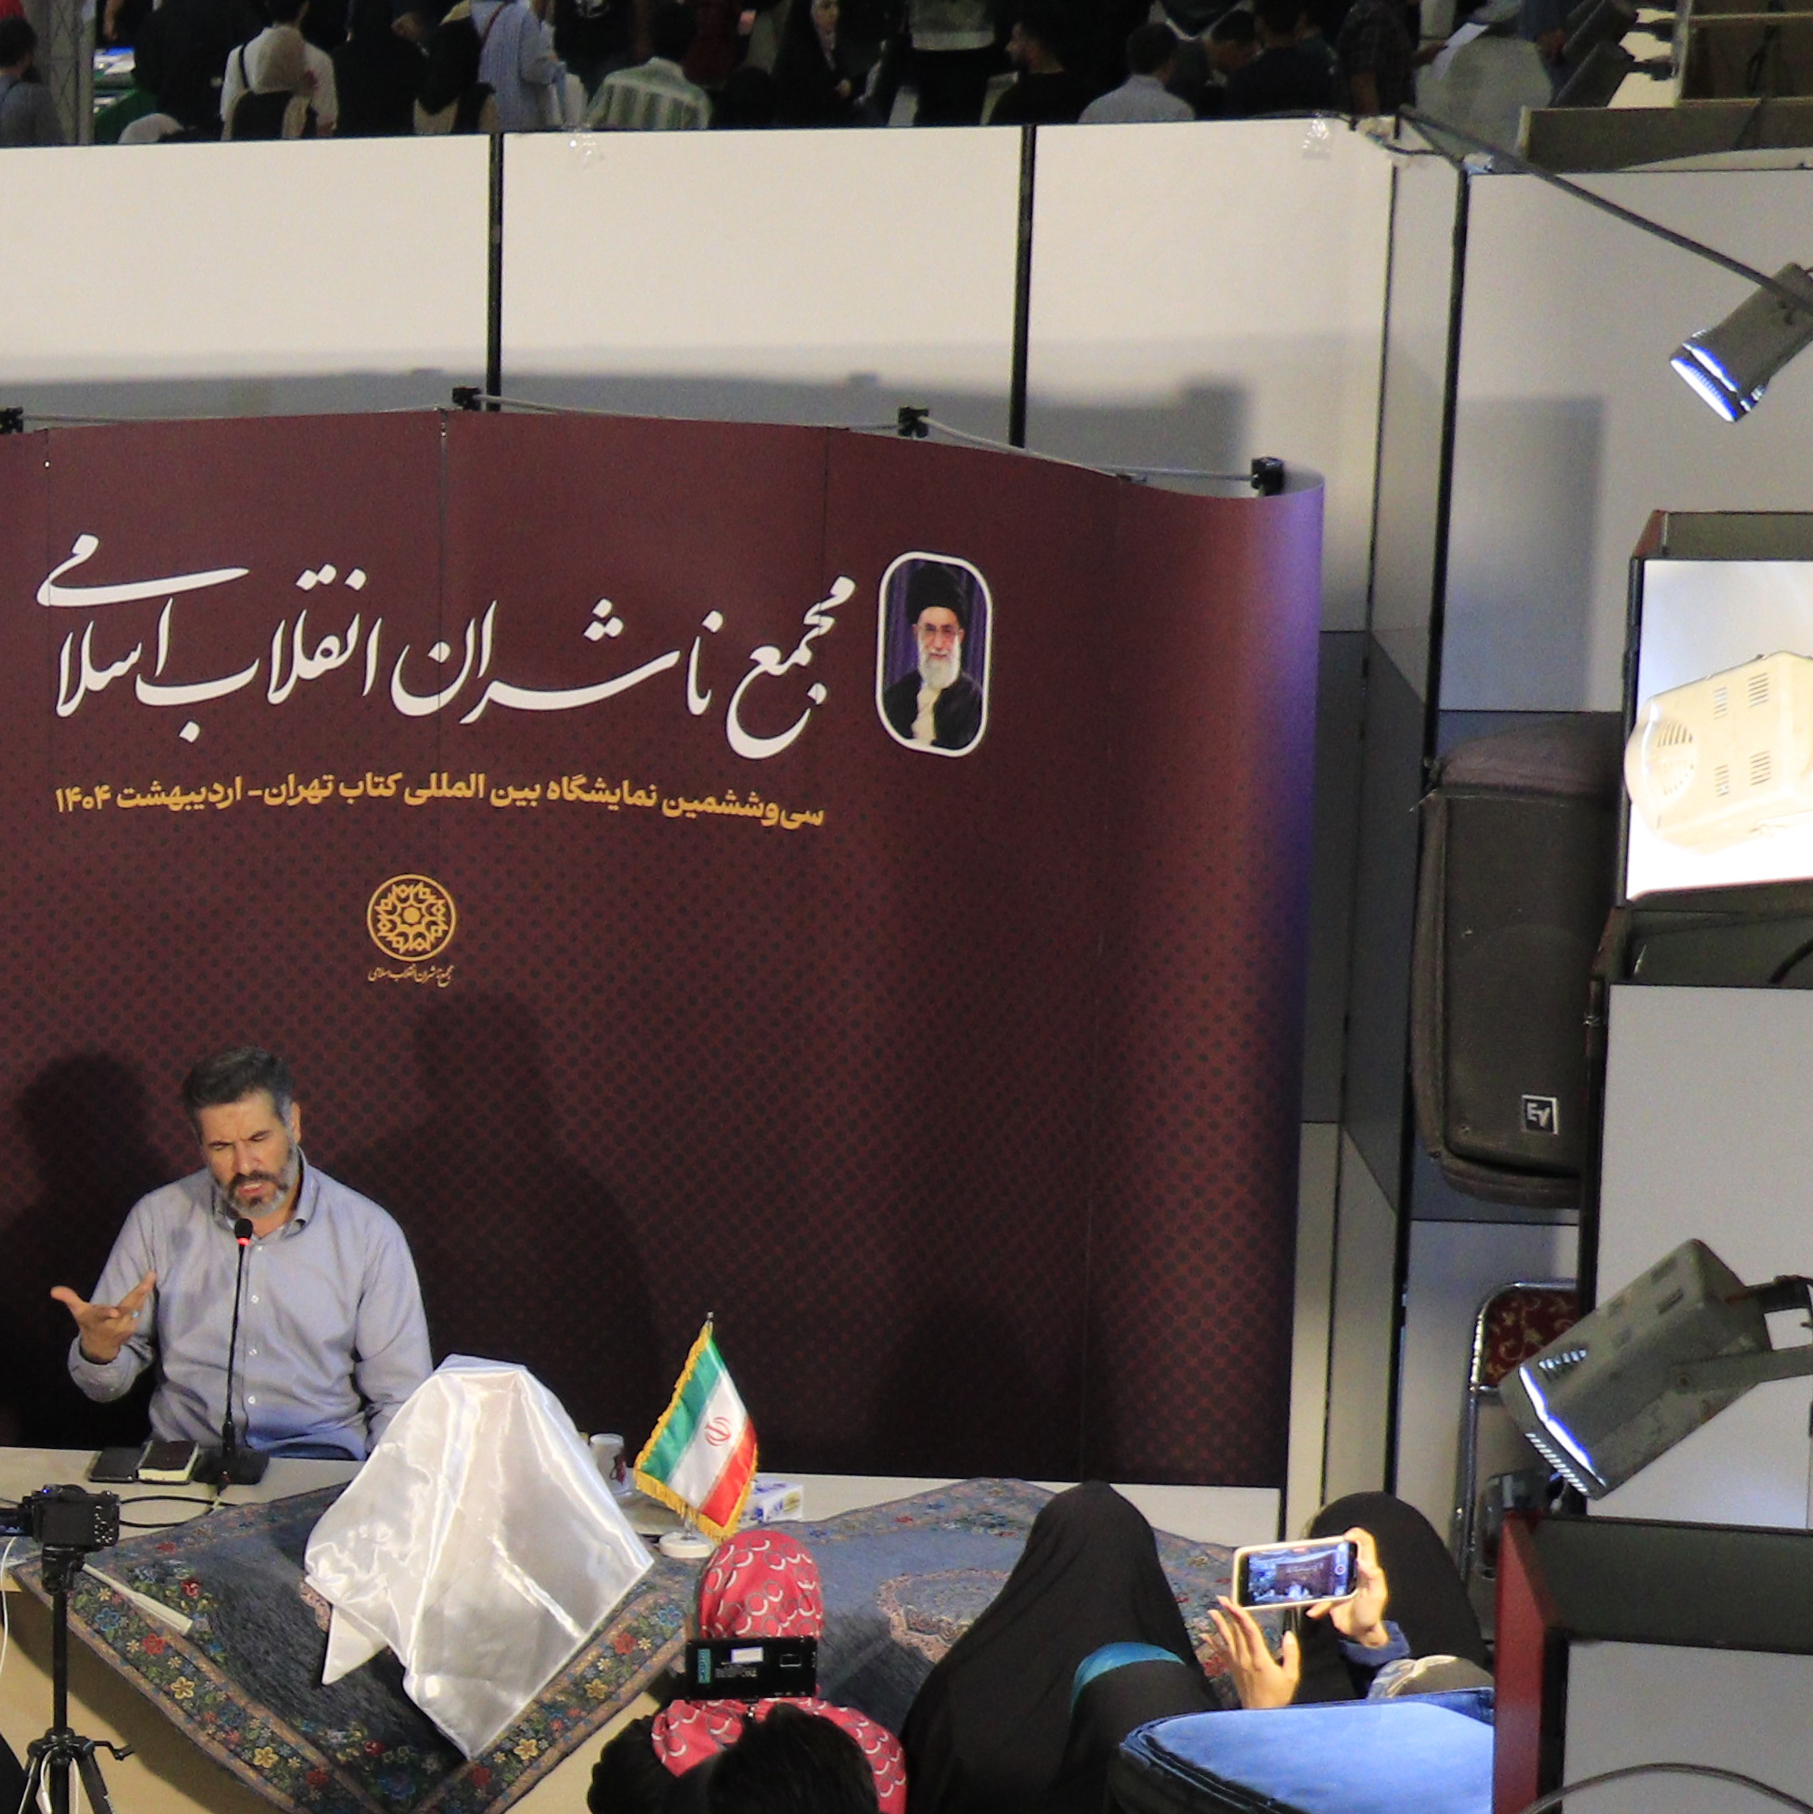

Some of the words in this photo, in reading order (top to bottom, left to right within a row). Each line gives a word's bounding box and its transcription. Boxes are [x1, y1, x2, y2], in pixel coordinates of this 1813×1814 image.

[36, 533, 250, 718] اسلامی
[136, 563, 382, 743] انقلاب
[390, 598, 723, 724] ناشران
[726, 575, 856, 760] مجمع
[55, 784, 112, 813] ۱۴۰۴
[116, 776, 242, 812] اردیبهشت
[337, 771, 403, 805] کتاب
[404, 772, 485, 807] المللی
[489, 781, 541, 807] بین
[546, 774, 658, 811] نمایشگاه
